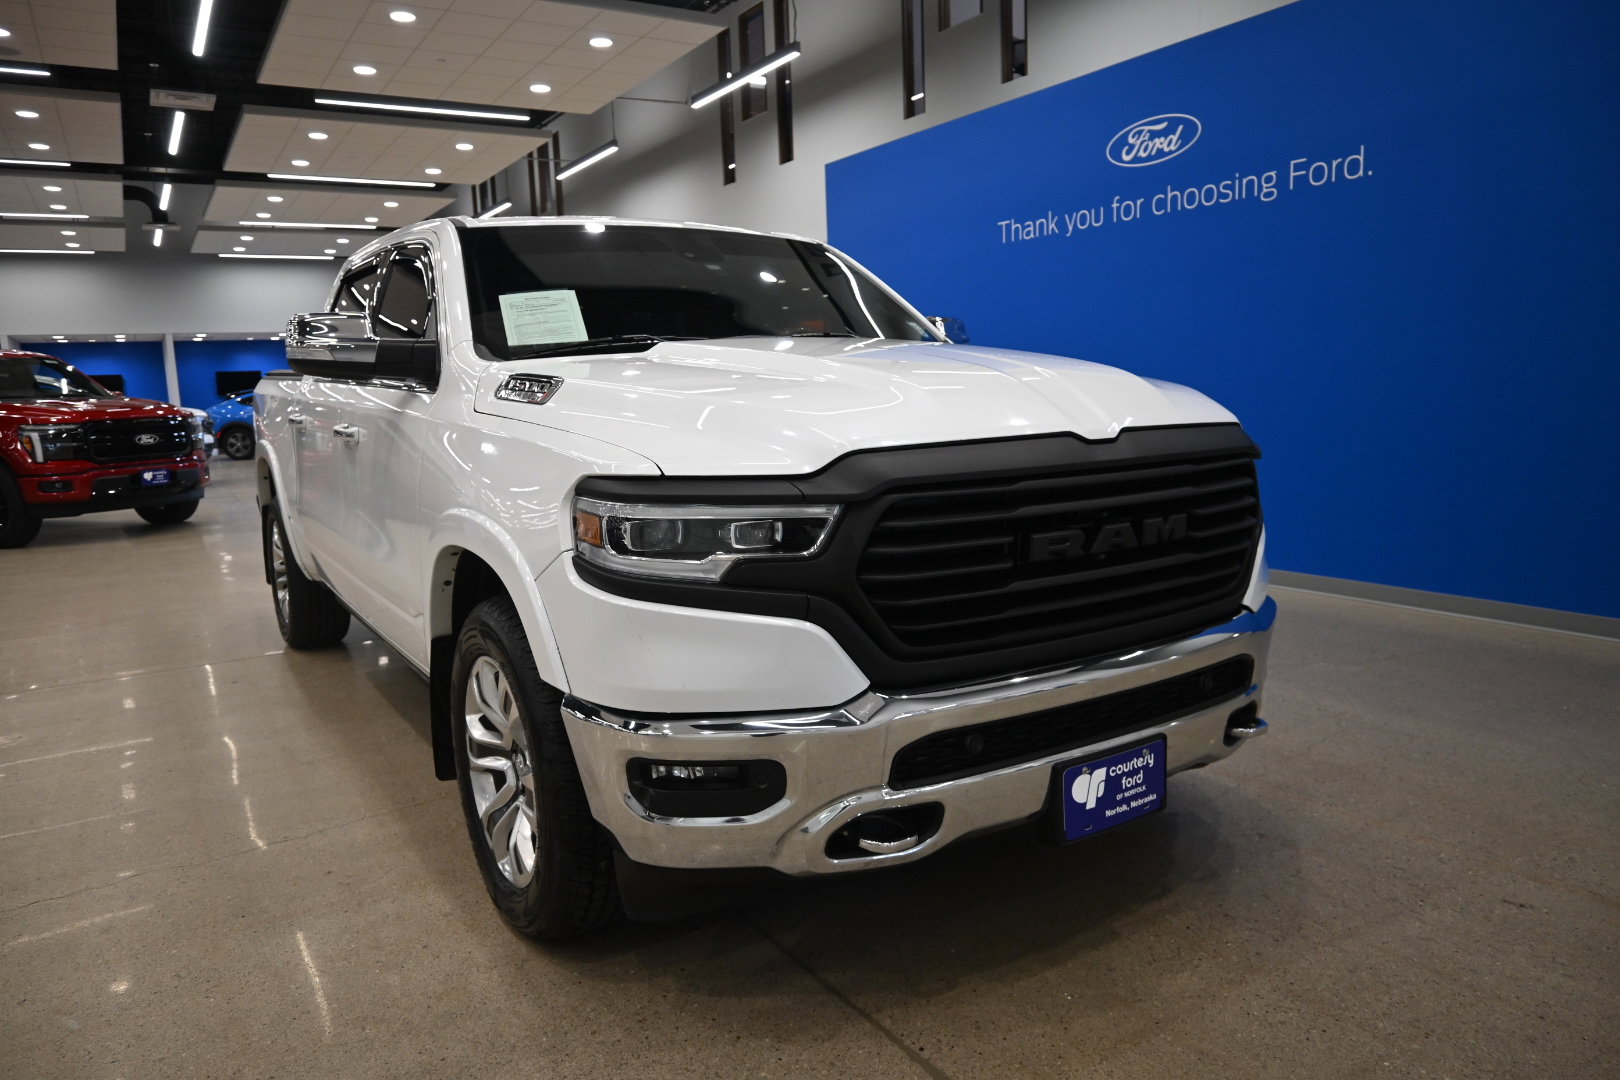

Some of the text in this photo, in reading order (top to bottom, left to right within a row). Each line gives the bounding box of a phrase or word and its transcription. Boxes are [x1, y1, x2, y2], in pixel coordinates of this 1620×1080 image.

[1121, 121, 1184, 162] Ford
[997, 145, 1373, 244] Thank you for choosing Ford.
[1029, 513, 1187, 562] RAM
[1109, 753, 1154, 776] courtesy
[1121, 770, 1143, 789] ford
[1124, 785, 1146, 797] NORFOLK
[1105, 793, 1157, 818] Norfolk, Nebraska
